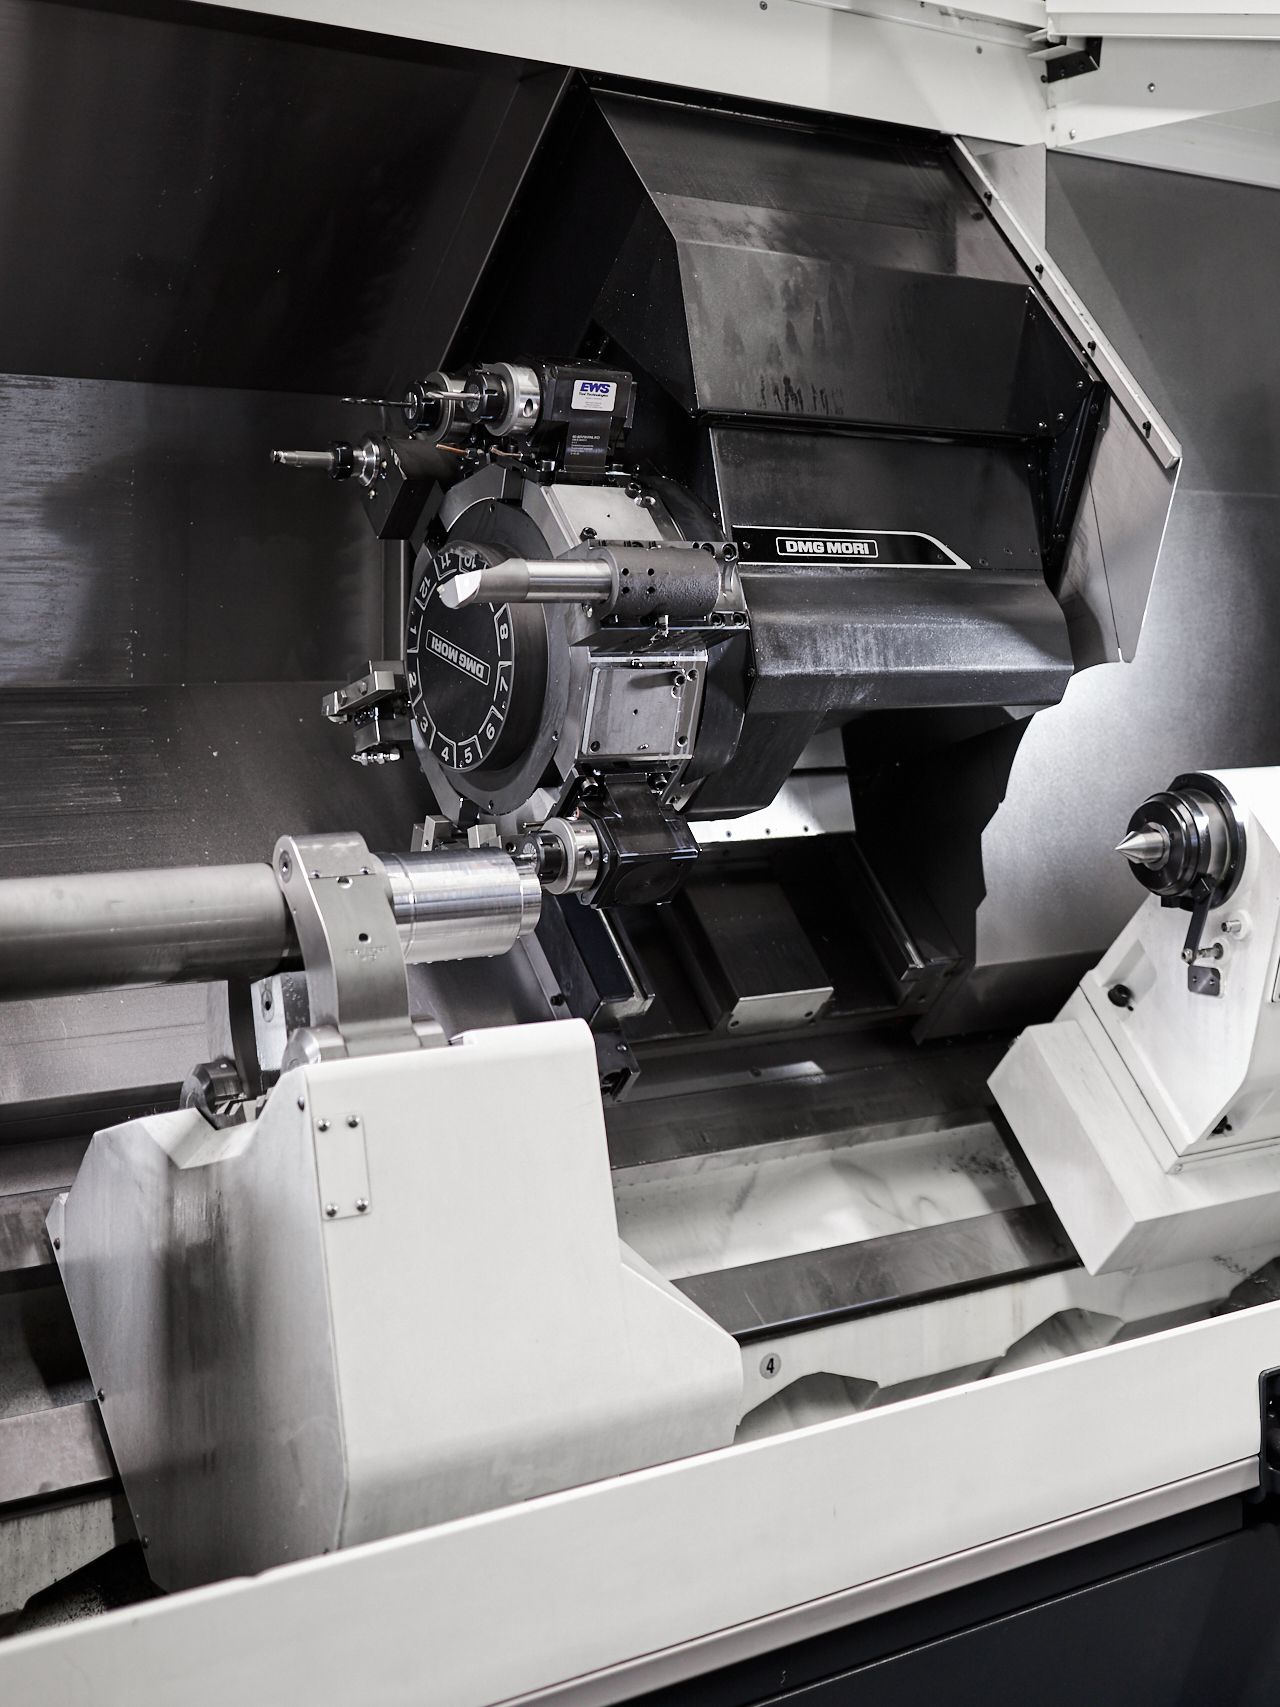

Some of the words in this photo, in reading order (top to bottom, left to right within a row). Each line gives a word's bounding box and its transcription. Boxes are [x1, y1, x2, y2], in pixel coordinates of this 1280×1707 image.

[580, 382, 611, 394] EWS
[785, 540, 825, 553] DMG
[826, 542, 870, 555] MORI
[419, 576, 431, 598] 12
[499, 623, 509, 640] 8
[431, 636, 459, 663] MORI
[458, 653, 485, 679] DMG
[408, 671, 417, 688] 2
[499, 676, 509, 692] 7
[420, 716, 429, 733] 3
[486, 723, 495, 740] 6
[441, 746, 450, 762] 4
[464, 747, 473, 764] 5
[766, 1357, 774, 1374] 4
